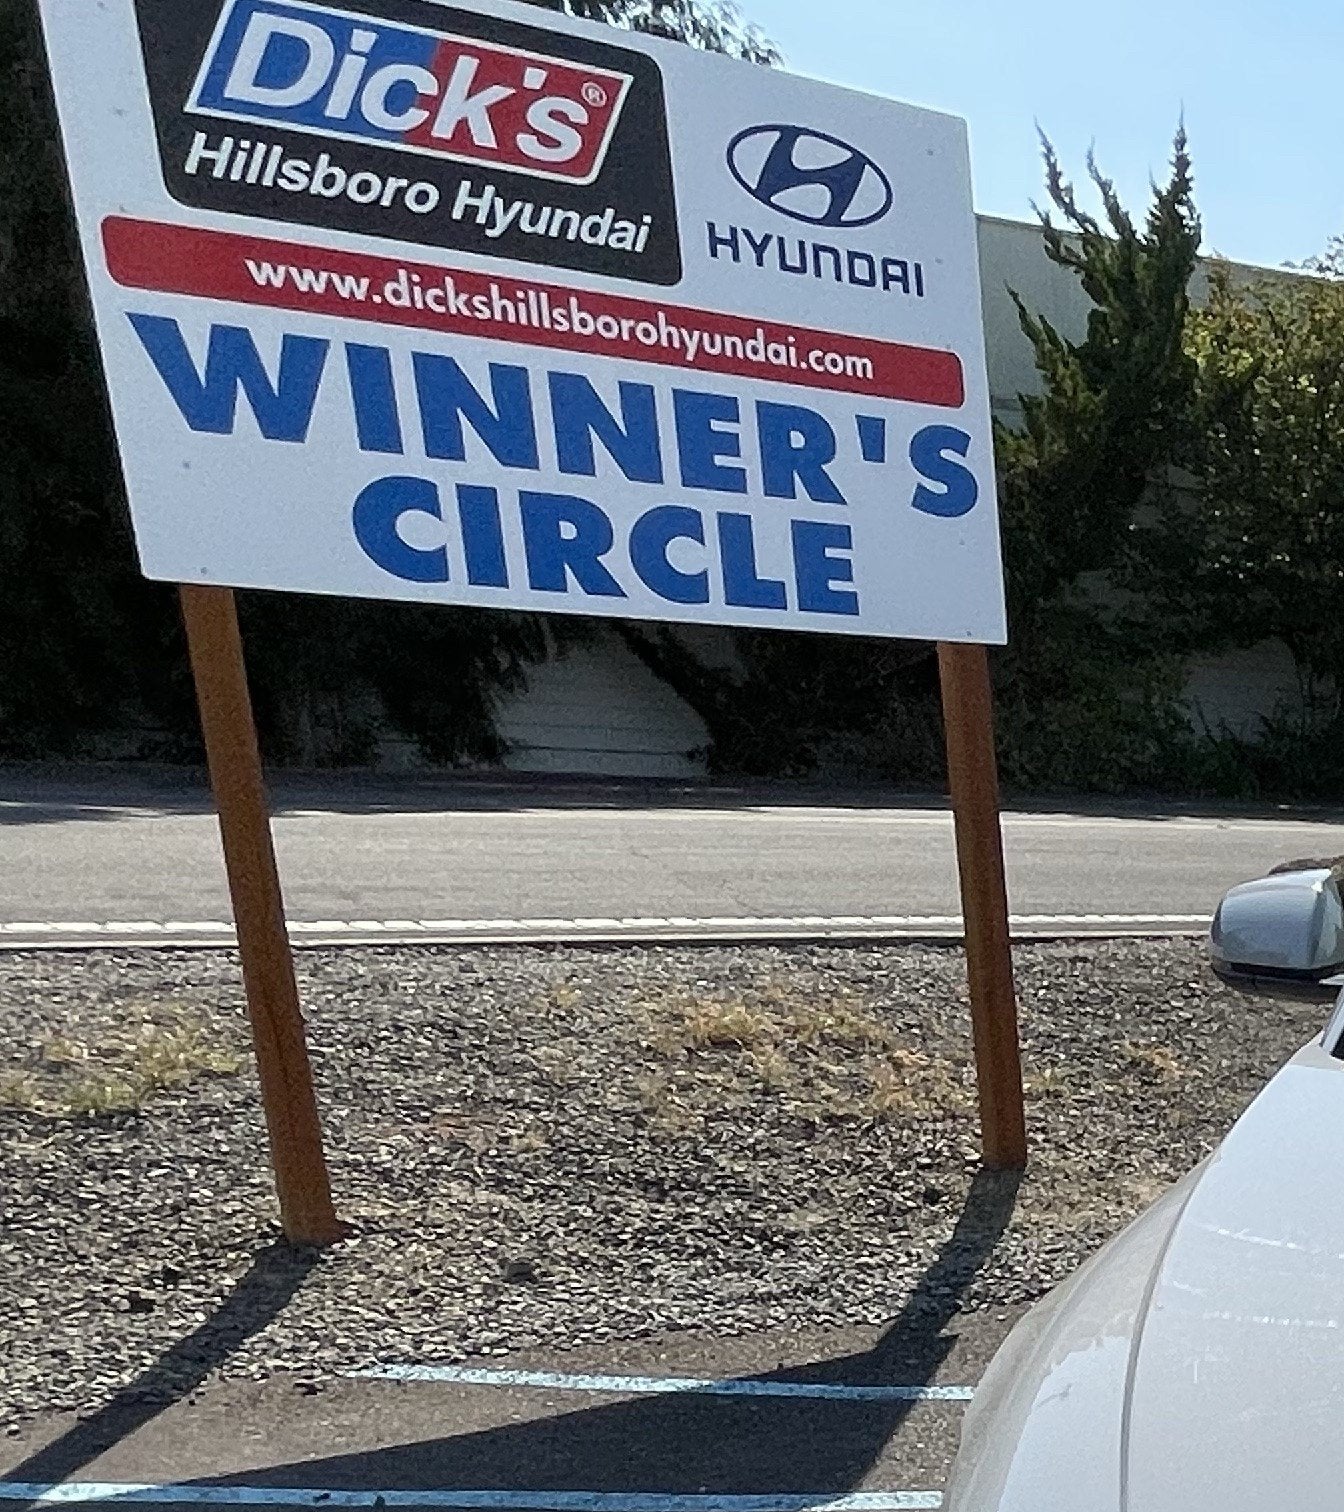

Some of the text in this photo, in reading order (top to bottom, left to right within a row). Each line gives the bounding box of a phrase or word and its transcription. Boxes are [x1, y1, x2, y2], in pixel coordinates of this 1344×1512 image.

[184, 130, 651, 253] Hillsboro Hyundai
[245, 258, 874, 380] www.dickshillsborohyundai.com
[706, 221, 925, 298] HYUNDAI
[127, 312, 979, 519] WINNER'S
[351, 475, 860, 616] CIRCLE
